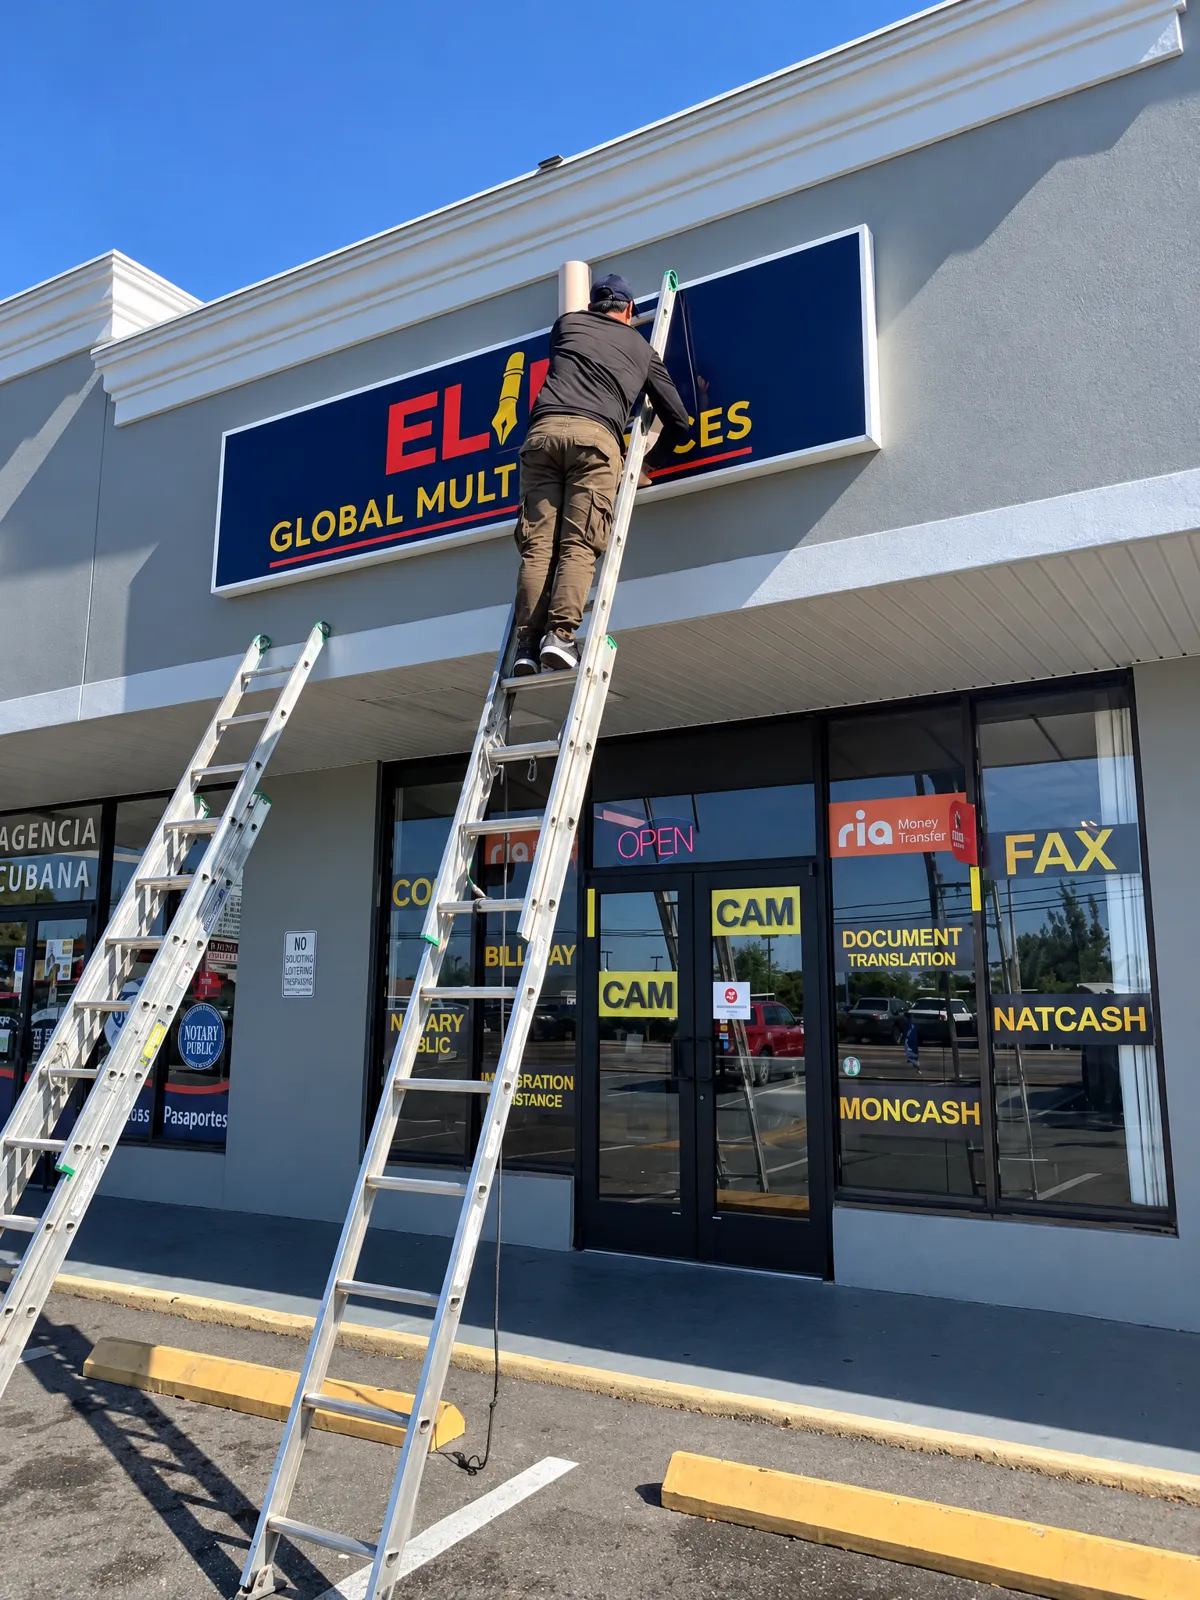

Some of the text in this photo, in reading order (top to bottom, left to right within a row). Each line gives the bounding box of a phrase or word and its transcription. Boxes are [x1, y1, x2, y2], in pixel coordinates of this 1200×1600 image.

[269, 493, 404, 553] GLOBAL
[416, 462, 518, 519] MULT
[0, 817, 97, 852] AGENCIA
[837, 808, 939, 849] ria Money
[898, 829, 947, 844] Transfer
[617, 825, 693, 859] OPEN
[1005, 828, 1118, 876] FAX
[392, 877, 437, 907] CO
[716, 896, 795, 928] CAM
[294, 936, 307, 951] NO
[842, 927, 963, 949] DOCUMENT
[547, 944, 577, 966] AY
[847, 951, 957, 968] TRANSLATION
[602, 980, 674, 1010] CAM
[390, 1013, 465, 1033] NARY
[993, 1006, 1147, 1032] NATCASH
[184, 1025, 220, 1041] NOTARY
[417, 1036, 451, 1054] BLIC
[186, 1041, 215, 1055] PUBLIC
[481, 1072, 575, 1091] IMGRATION
[163, 1105, 228, 1131] Pasaportes
[839, 1096, 981, 1126] MONCASH
